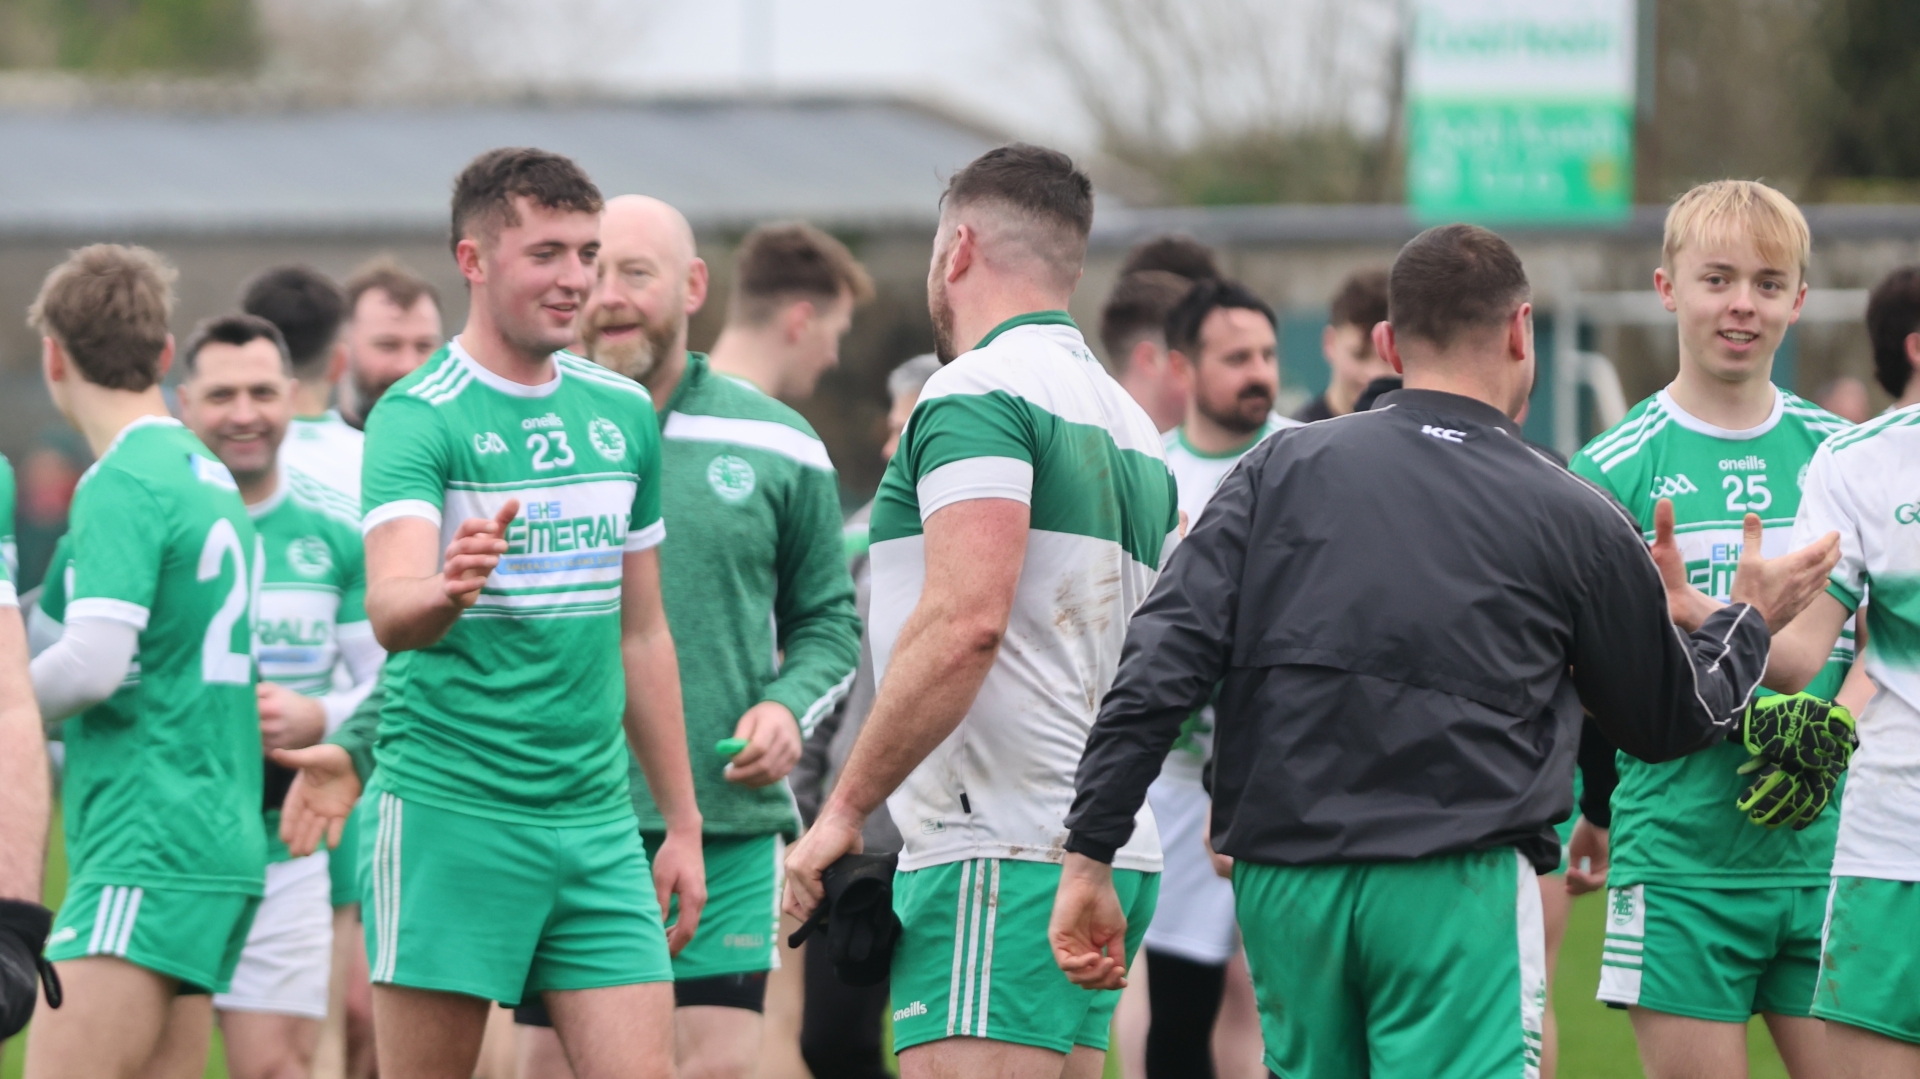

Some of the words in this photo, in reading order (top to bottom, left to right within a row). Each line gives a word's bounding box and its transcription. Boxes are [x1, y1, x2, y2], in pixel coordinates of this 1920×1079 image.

[526, 430, 576, 472] 23
[527, 501, 561, 520] EHS
[1721, 474, 1773, 512] 25
[505, 513, 632, 555] EMERAL
[1712, 543, 1744, 562] EH
